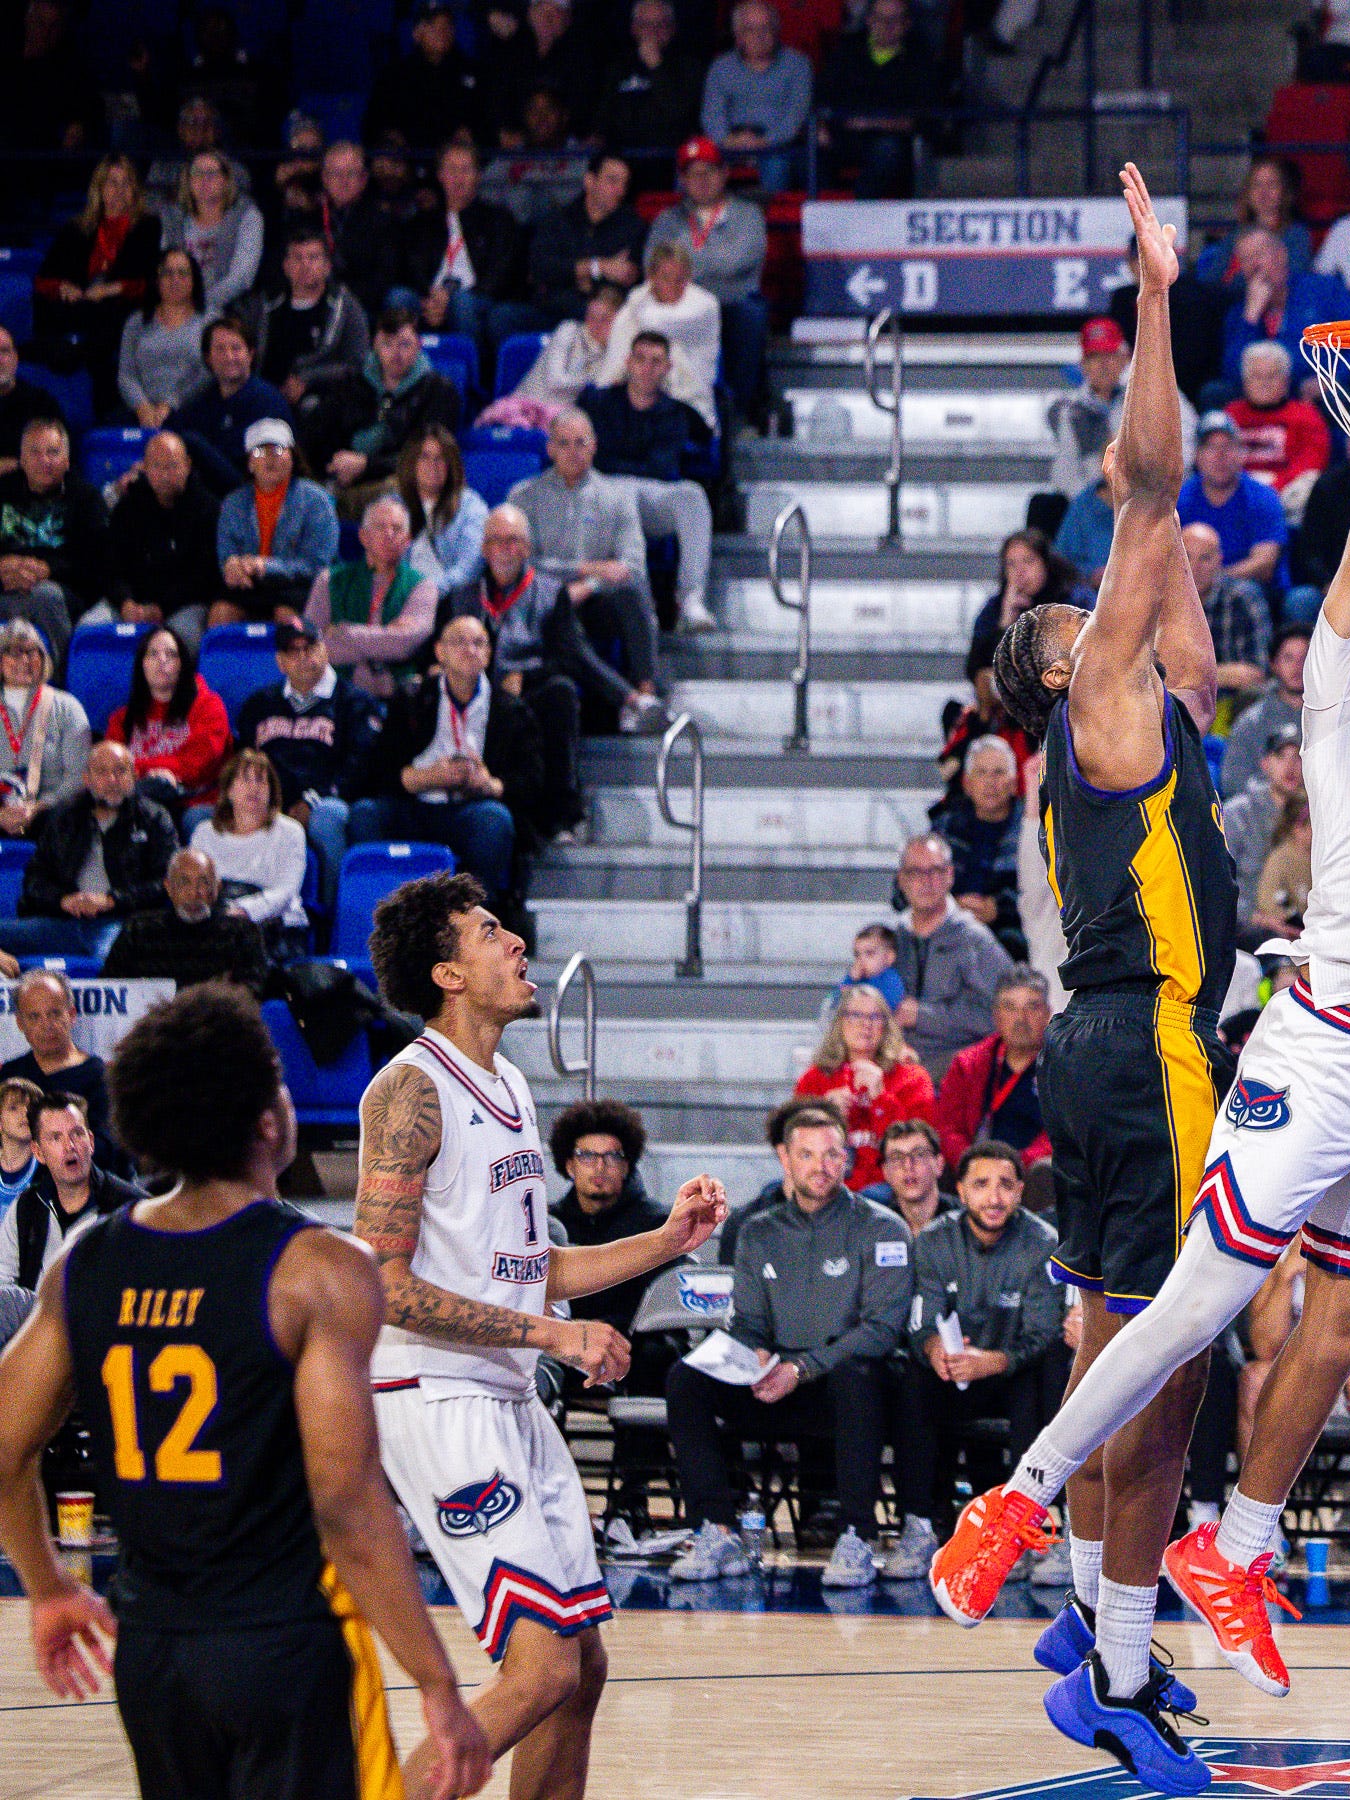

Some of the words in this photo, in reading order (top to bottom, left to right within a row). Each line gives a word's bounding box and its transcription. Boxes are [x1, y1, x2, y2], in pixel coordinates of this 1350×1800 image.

[905, 208, 1081, 245] SECTION
[902, 260, 938, 311] D
[1054, 258, 1088, 311] E
[522, 1190, 538, 1244] 1
[118, 1287, 205, 1327] RILEY
[101, 1343, 222, 1482] 12
